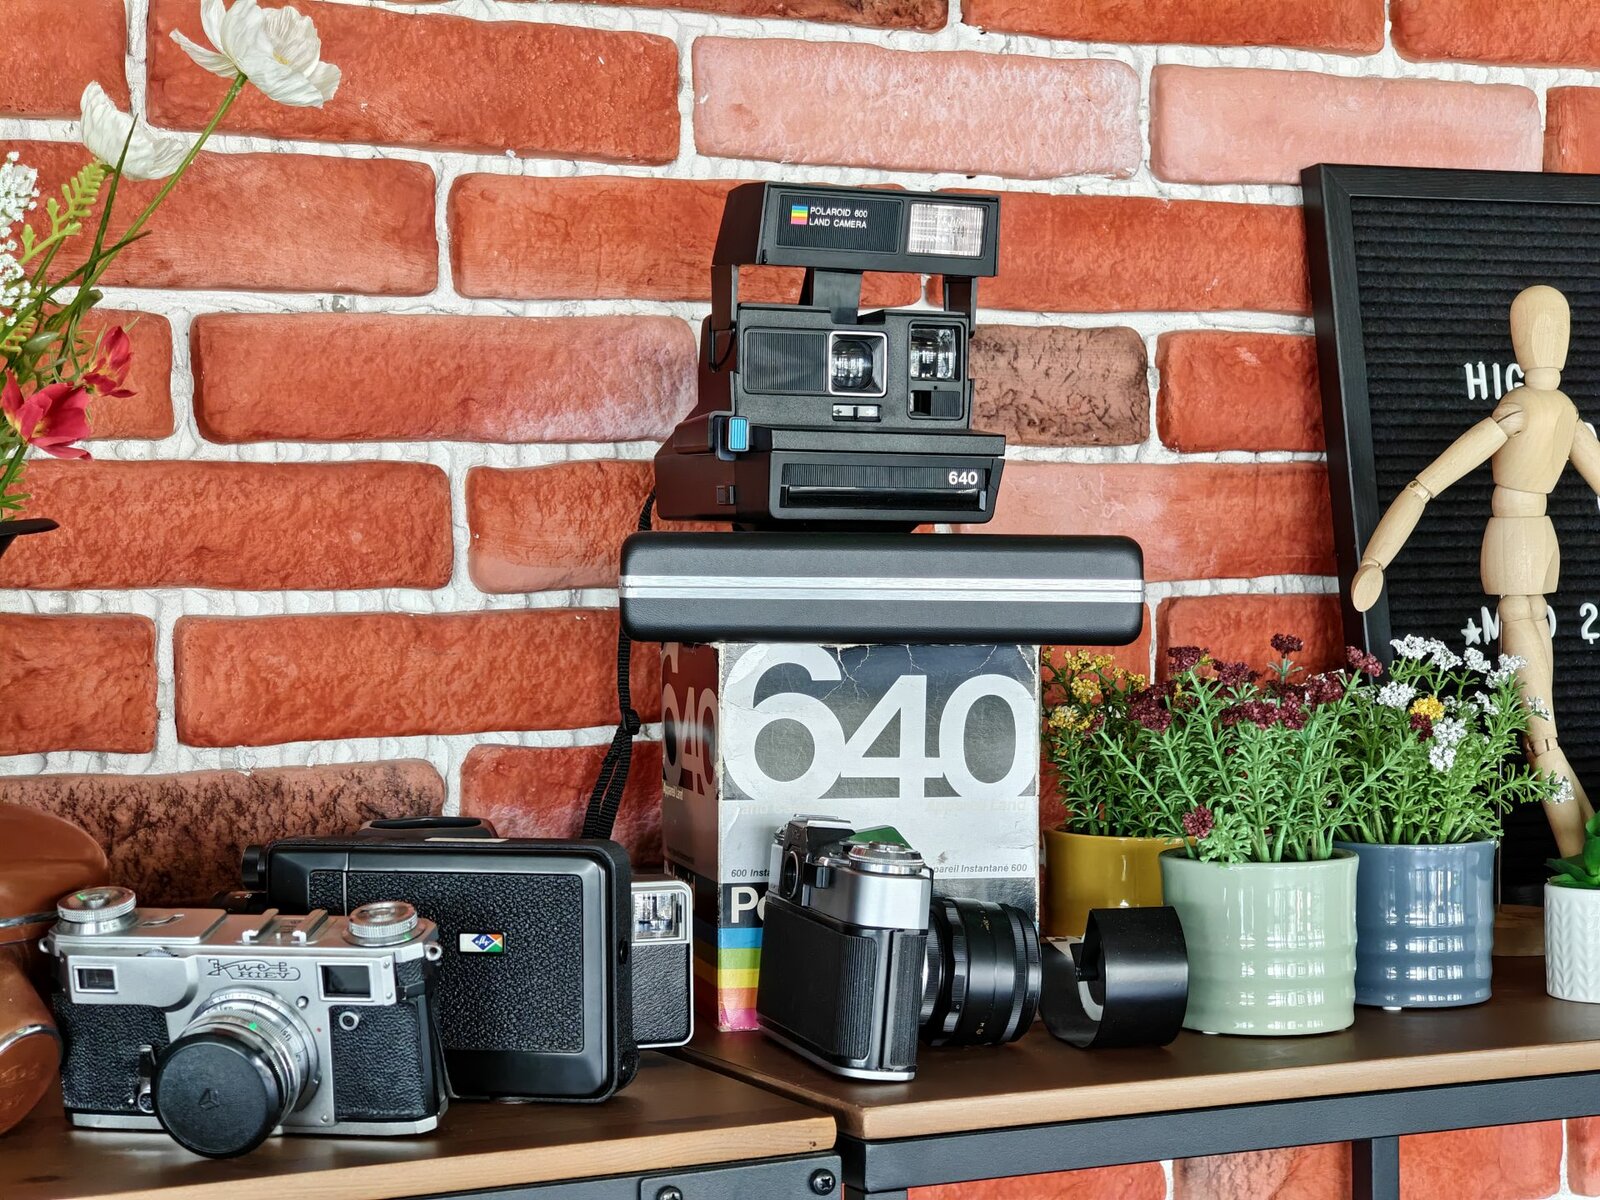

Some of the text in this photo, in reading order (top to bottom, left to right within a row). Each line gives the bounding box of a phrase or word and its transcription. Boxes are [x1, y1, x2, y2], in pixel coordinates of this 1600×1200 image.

[810, 206, 868, 218] POLAROID 600
[809, 218, 867, 229] LAND CAMERA
[948, 471, 978, 485] 640
[723, 643, 1036, 800] 640
[731, 869, 747, 878] 600
[961, 863, 1009, 873] Instantané
[1011, 863, 1028, 872] 600
